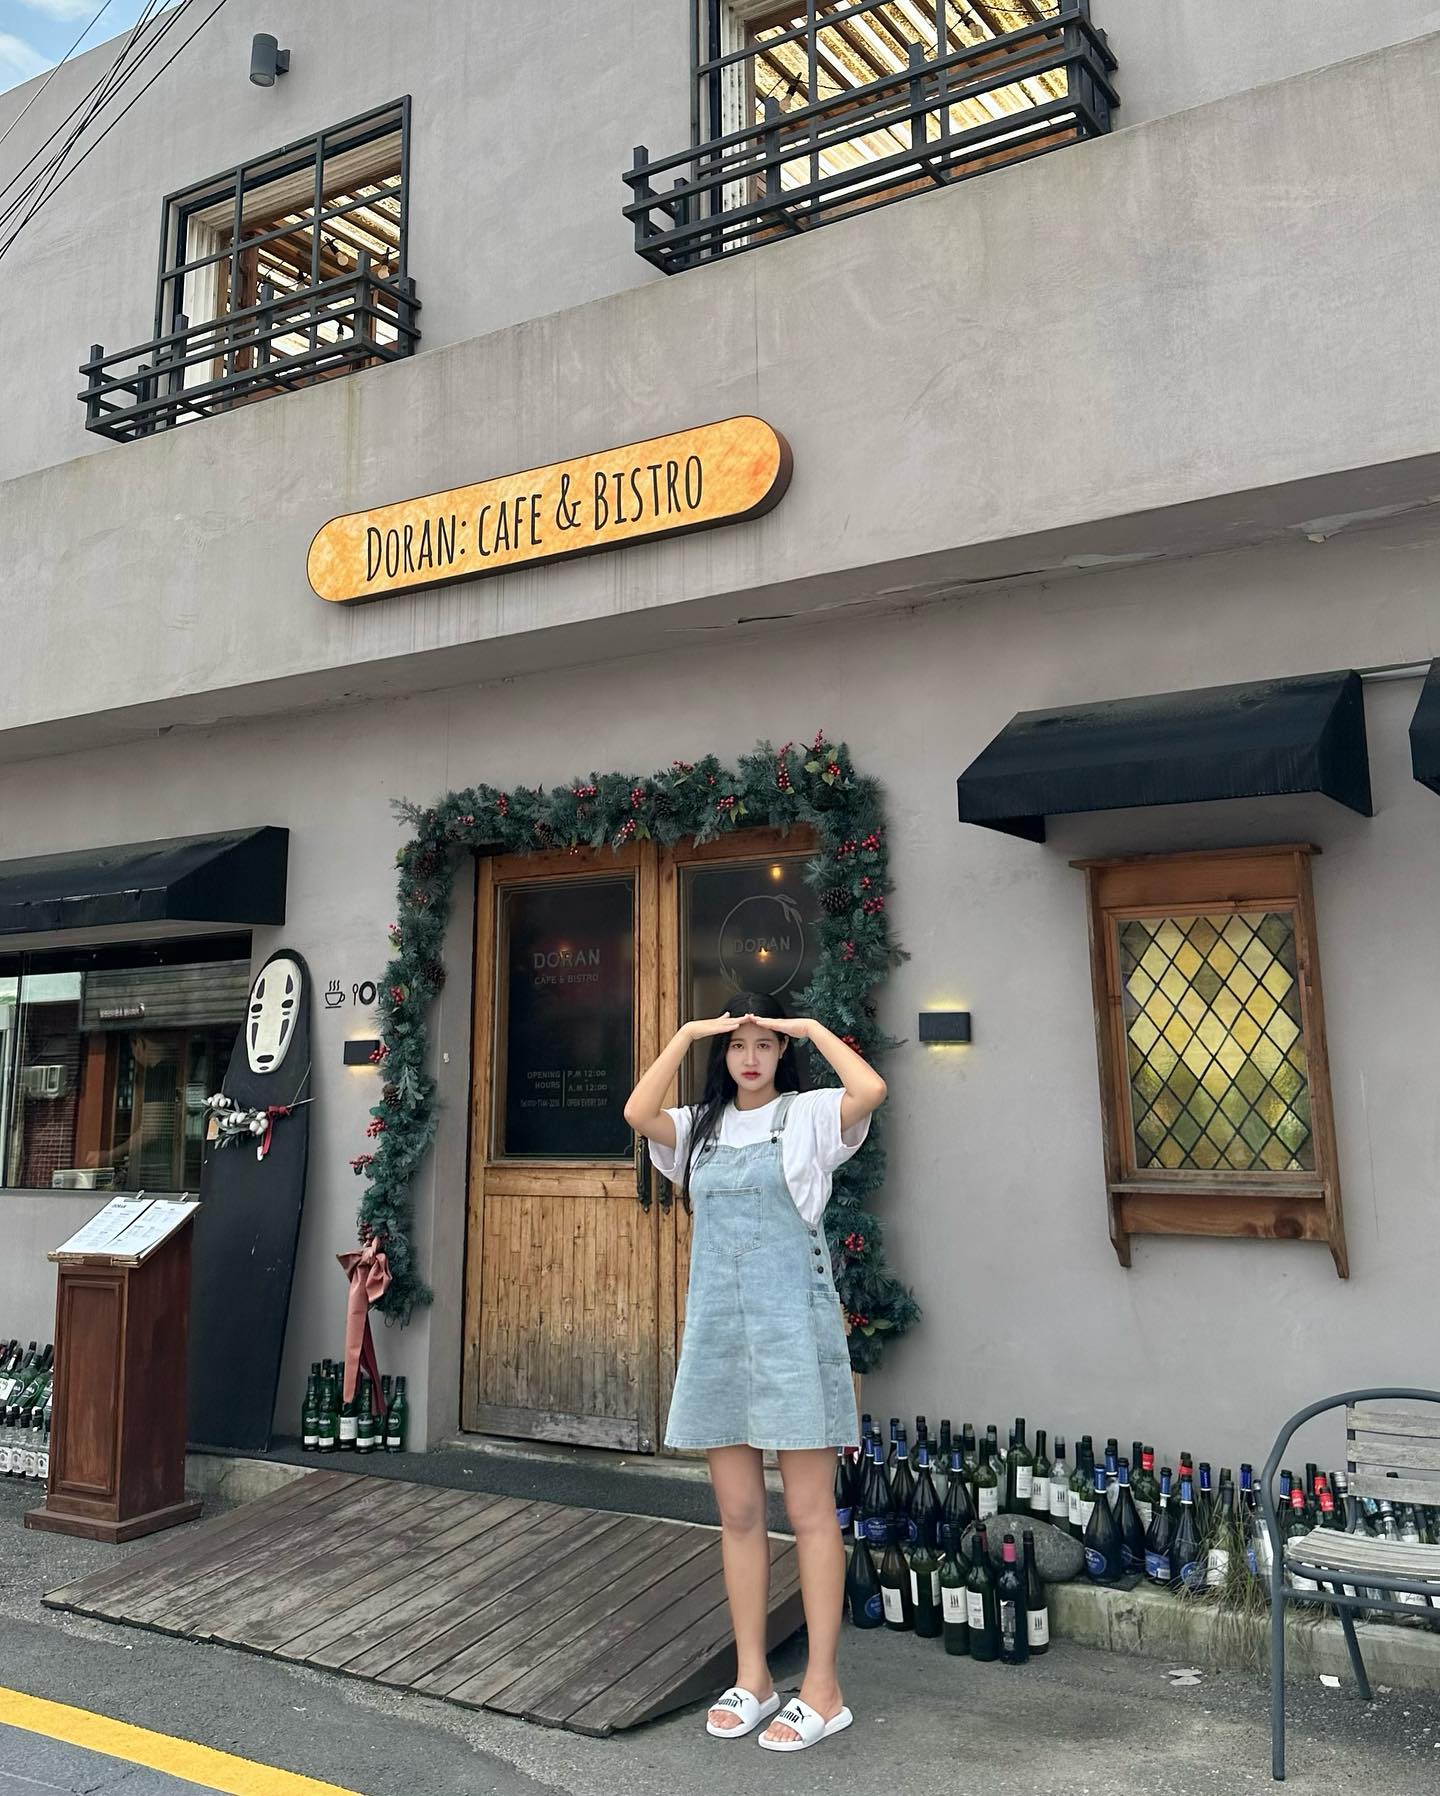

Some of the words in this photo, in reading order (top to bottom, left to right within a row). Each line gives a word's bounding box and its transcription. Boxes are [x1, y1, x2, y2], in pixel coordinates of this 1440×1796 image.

[366, 514, 466, 582] DORAN:
[478, 493, 543, 557] CAFE
[555, 473, 582, 530] &
[594, 455, 703, 531] BISTRO
[734, 935, 790, 953] DORAN
[533, 948, 601, 969] DORAN
[534, 975, 557, 985] CAFE
[567, 972, 599, 984] BISTRO
[527, 1071, 561, 1079] OPENING
[535, 1081, 561, 1089] HOURS
[585, 1083, 608, 1091] 12:00
[780, 1710, 799, 1723] UMA
